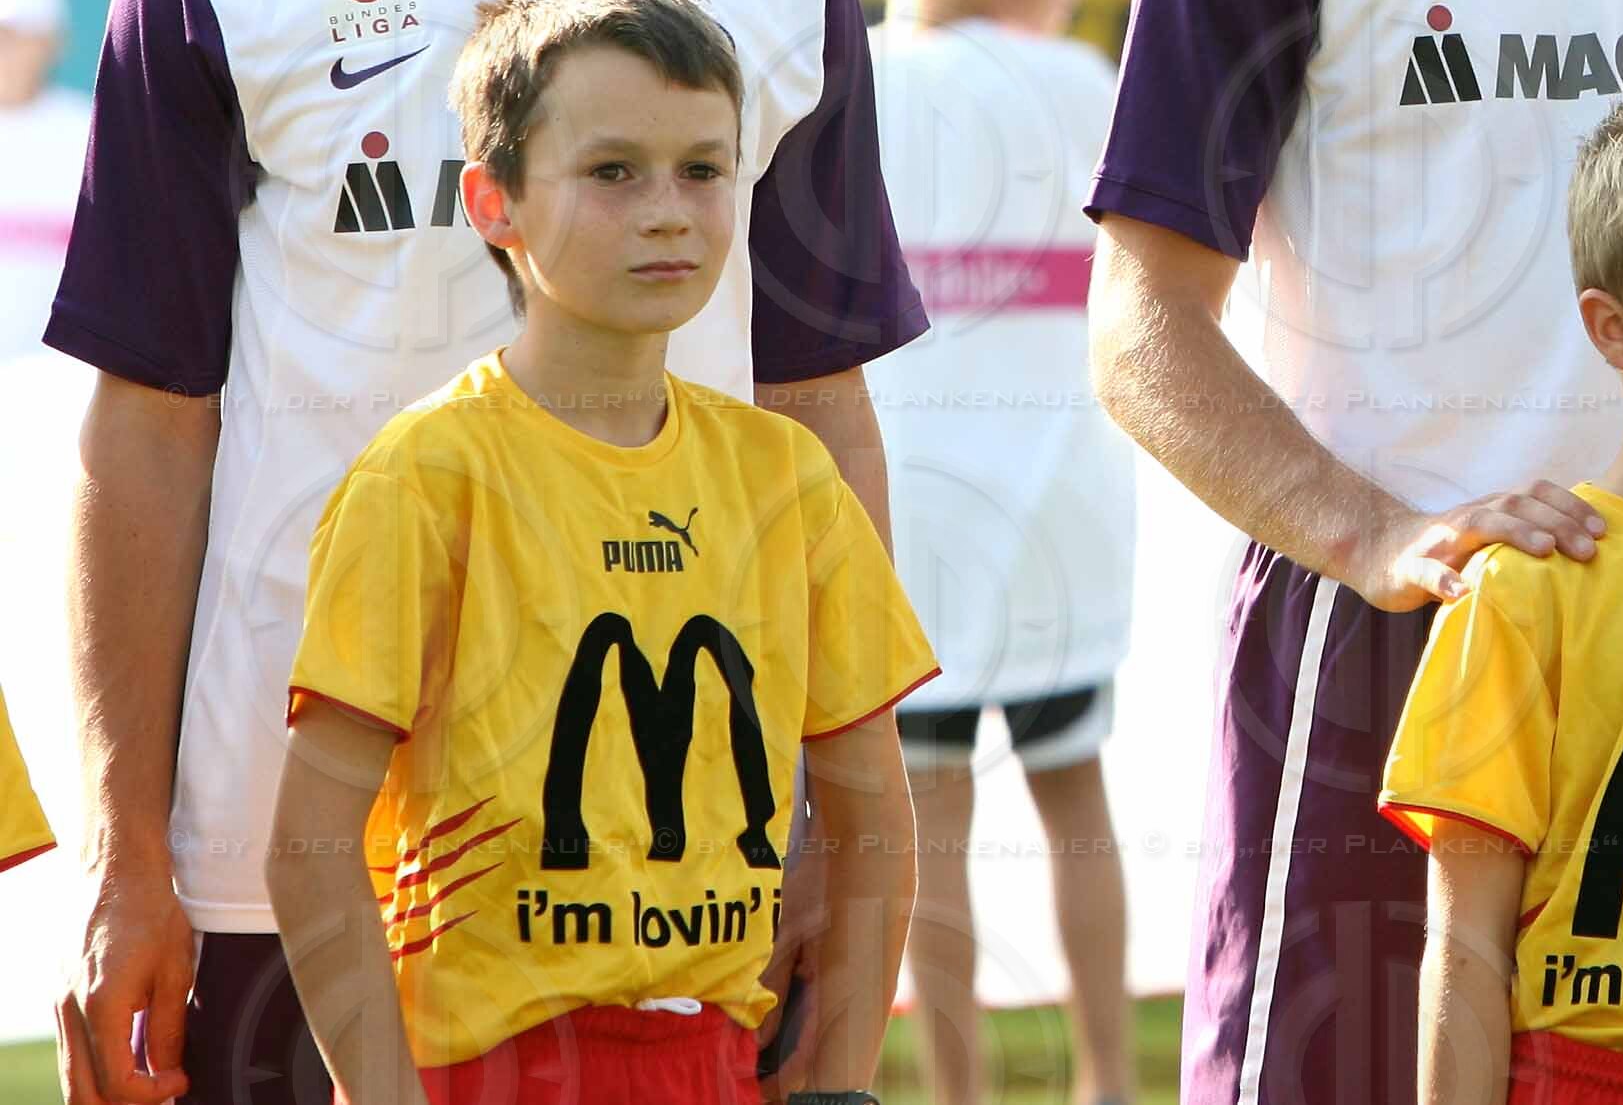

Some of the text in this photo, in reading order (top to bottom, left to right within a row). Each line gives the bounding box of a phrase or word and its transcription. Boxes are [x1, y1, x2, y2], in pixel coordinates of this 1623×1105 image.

[330, 1, 417, 25] BUNDES
[331, 14, 419, 43] LIGA
[602, 541, 684, 573] PUMA
[517, 887, 783, 948] i'm lovin' i
[1541, 954, 1623, 1007] i'm
